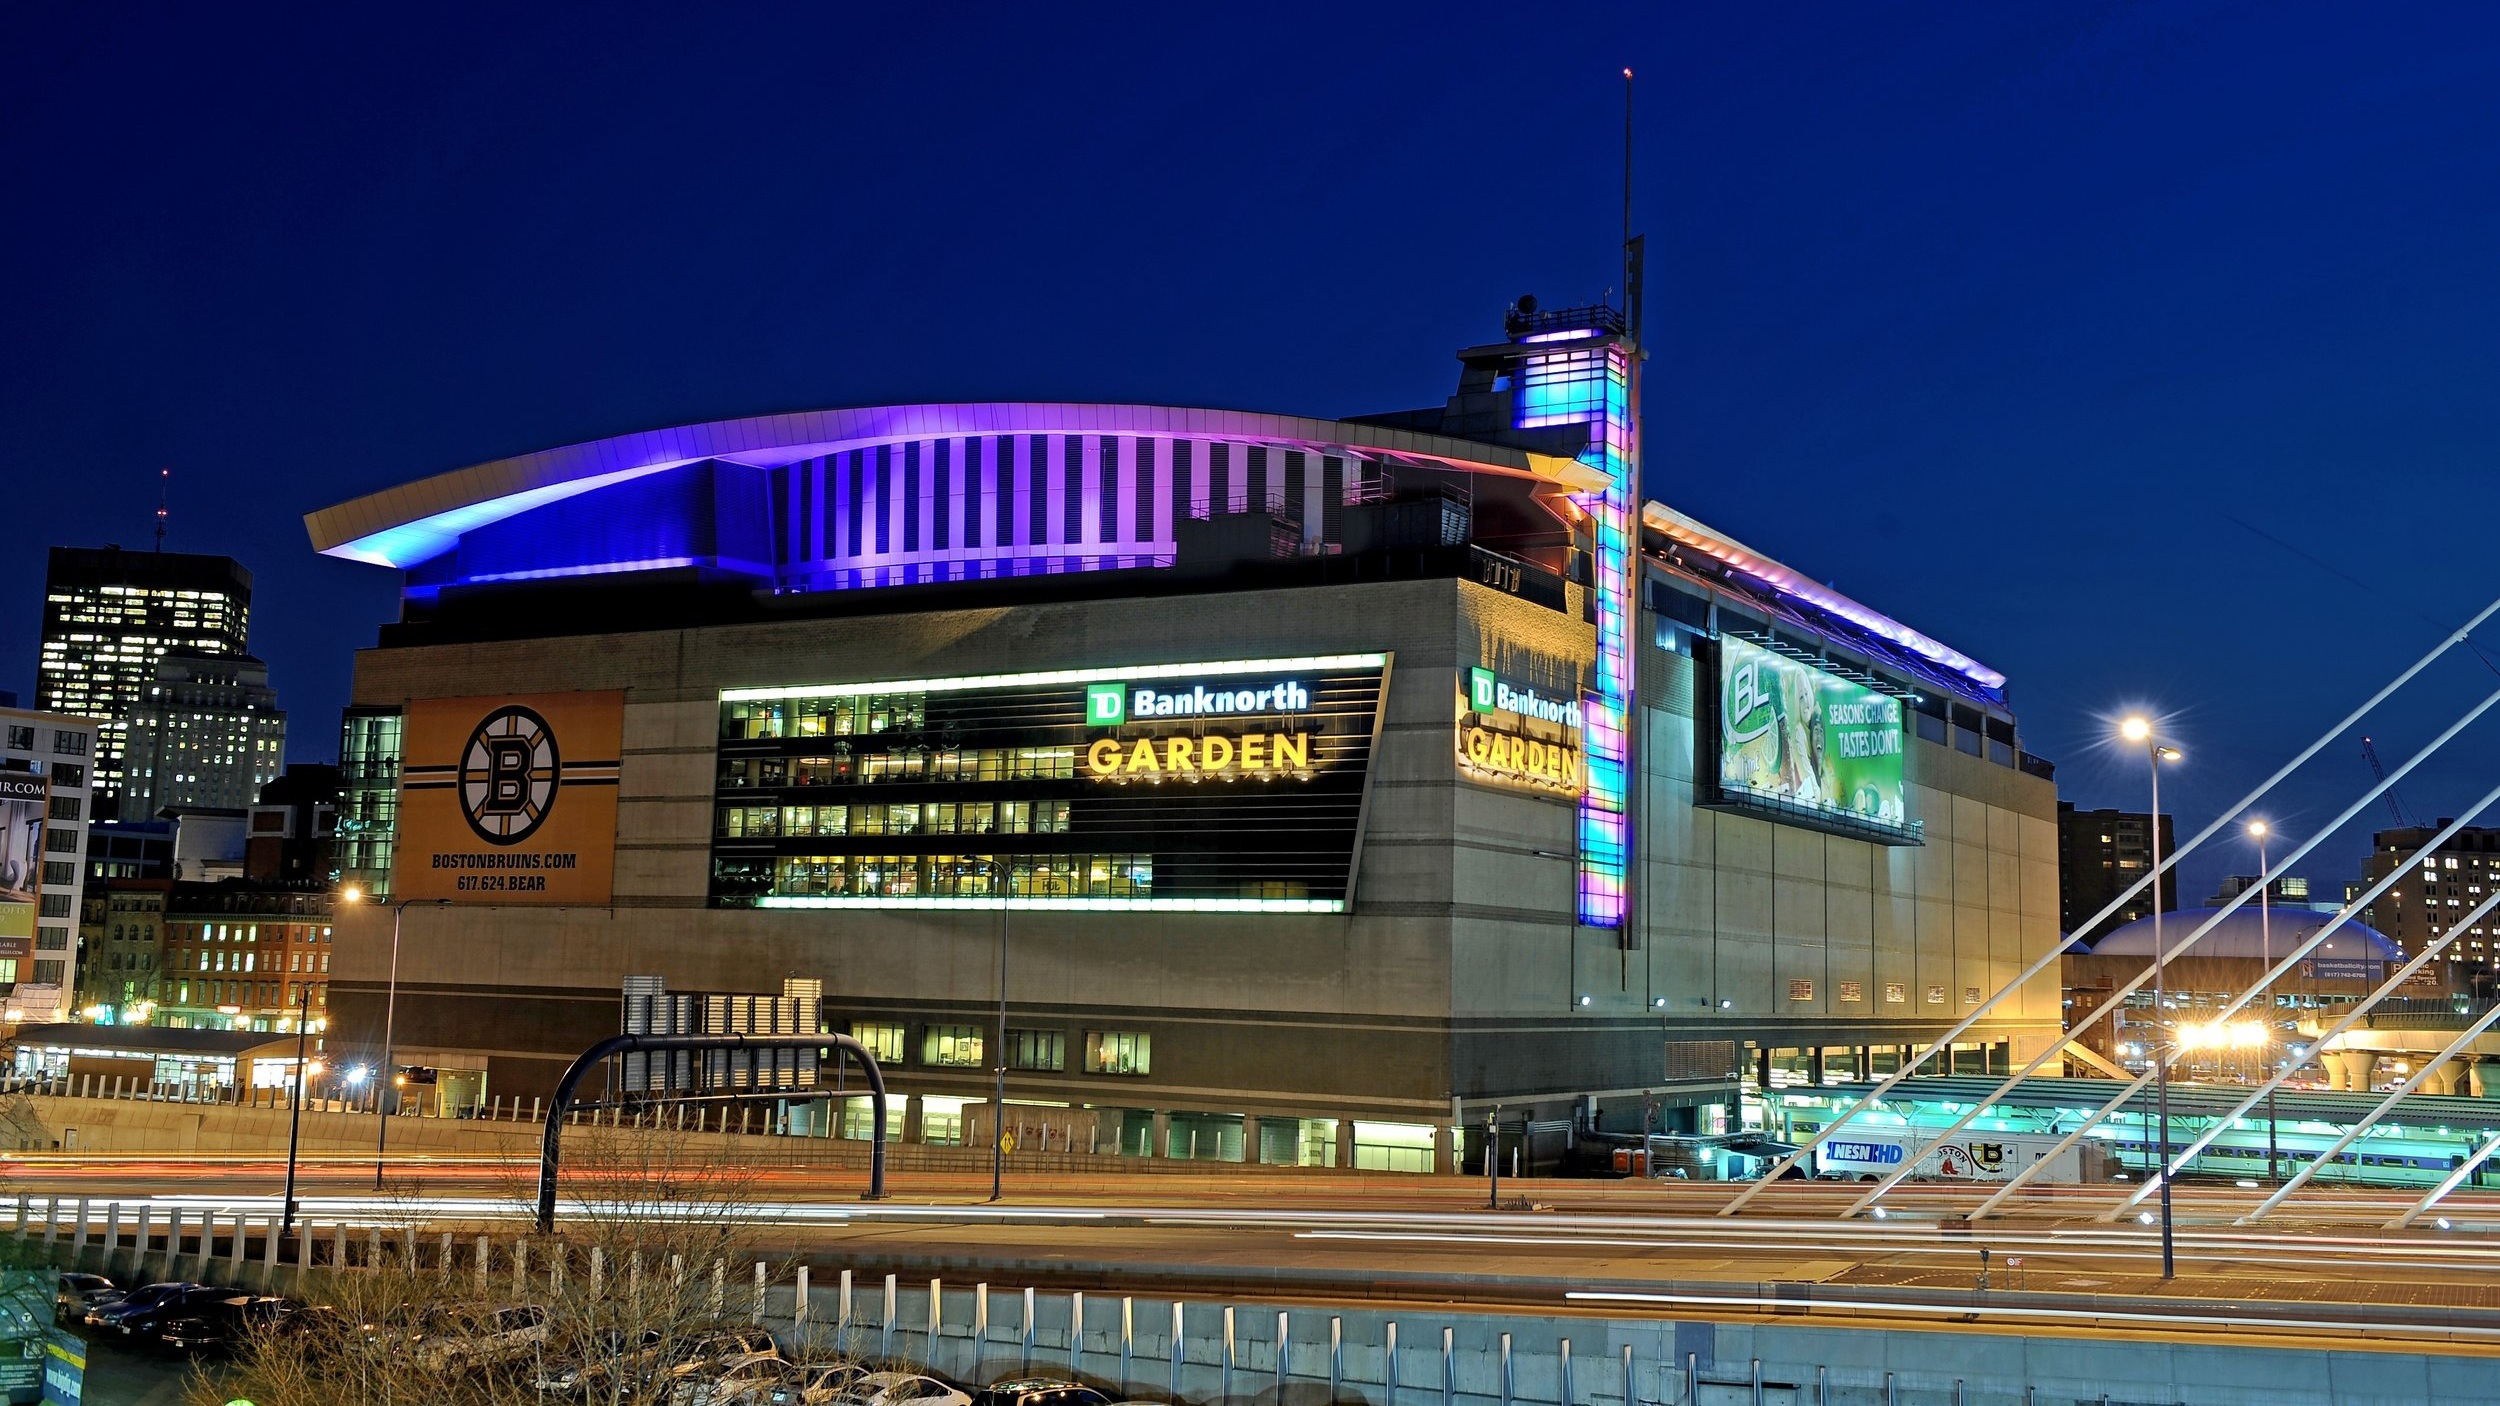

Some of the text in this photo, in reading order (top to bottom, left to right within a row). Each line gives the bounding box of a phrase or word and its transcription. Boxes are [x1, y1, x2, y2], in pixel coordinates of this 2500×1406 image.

[1091, 681, 1307, 718] TD Banknorth
[1474, 677, 1581, 728] TD Banknorth
[1829, 703, 1899, 724] SEASONS CHANGE.
[1088, 733, 1308, 774] GARDEN
[1468, 727, 1578, 781] GARDEN
[1839, 729, 1900, 758] TASTES DON'T.
[482, 735, 533, 814] B
[432, 854, 576, 868] BOSTONBRUINS.COM
[457, 876, 545, 890] 617.624.BEAR
[1834, 1144, 1903, 1163] NESN HD
